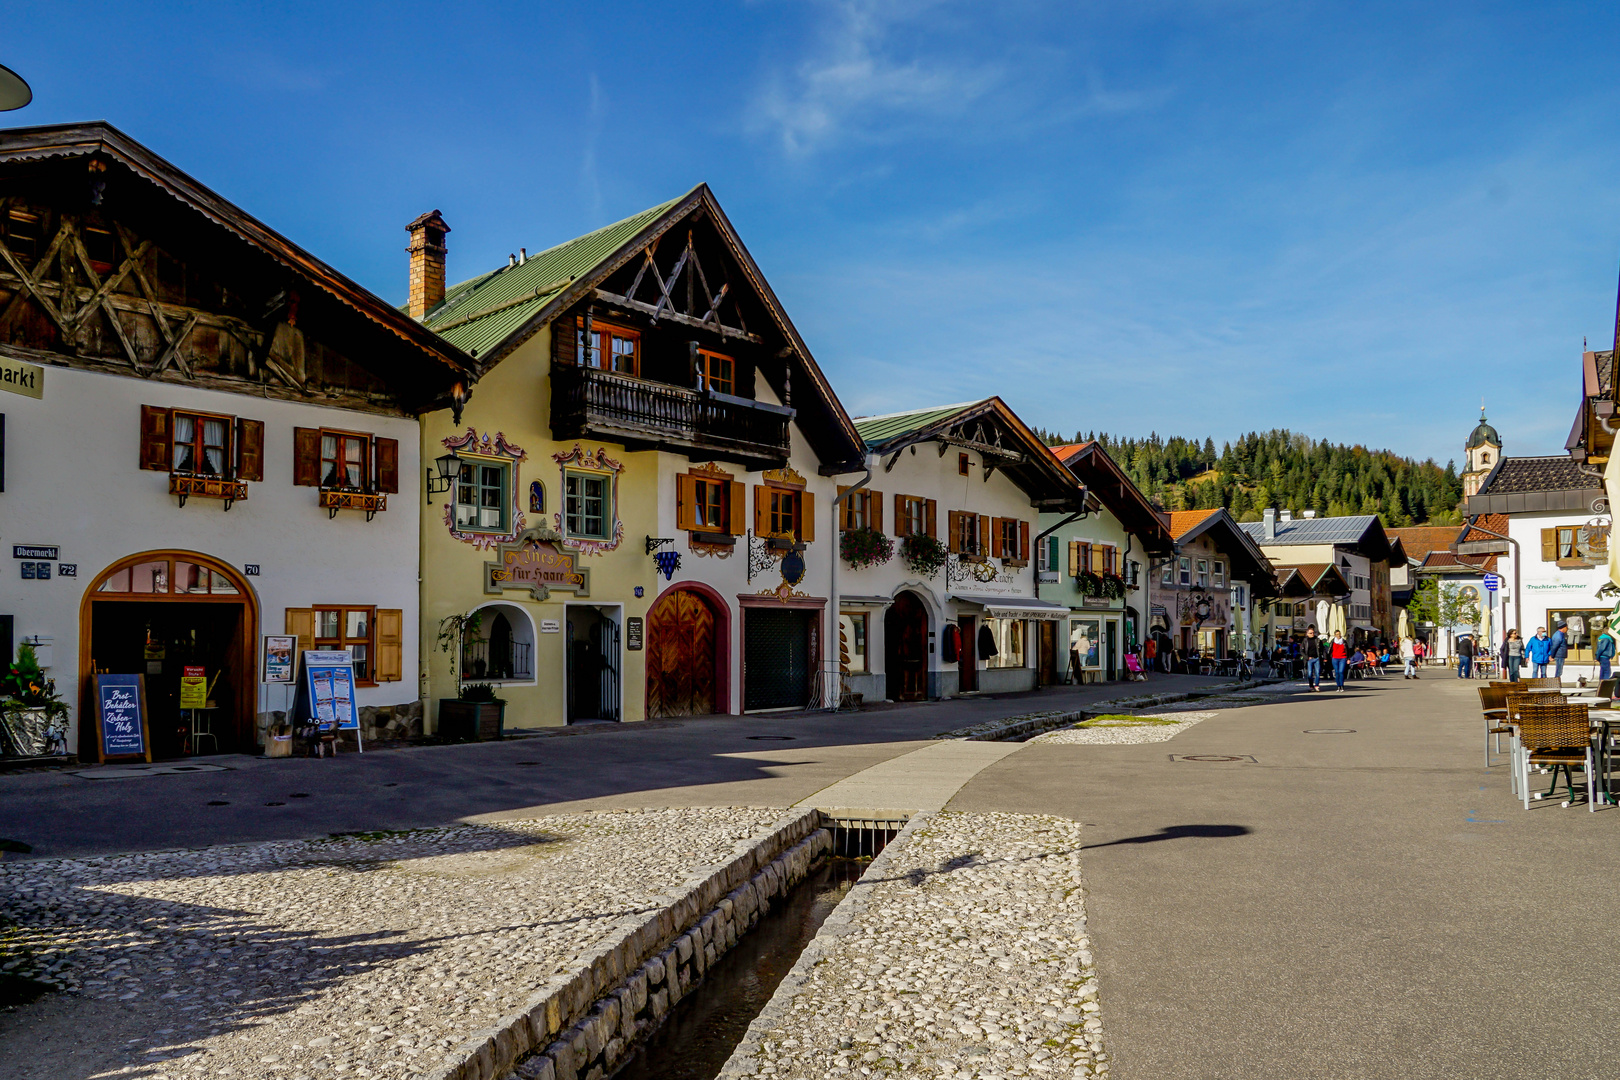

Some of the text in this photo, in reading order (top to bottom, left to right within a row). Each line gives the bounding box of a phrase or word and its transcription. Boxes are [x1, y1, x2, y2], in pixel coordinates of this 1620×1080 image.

[0, 367, 35, 388] arkt
[17, 547, 56, 558] Obermarkt
[524, 549, 554, 565] Ines
[60, 564, 76, 576] 72
[246, 565, 259, 575] 70
[513, 567, 565, 584] für Haare
[105, 699, 136, 710] Behälter
[106, 712, 133, 724] Zirben-
[115, 722, 134, 733] Holz
